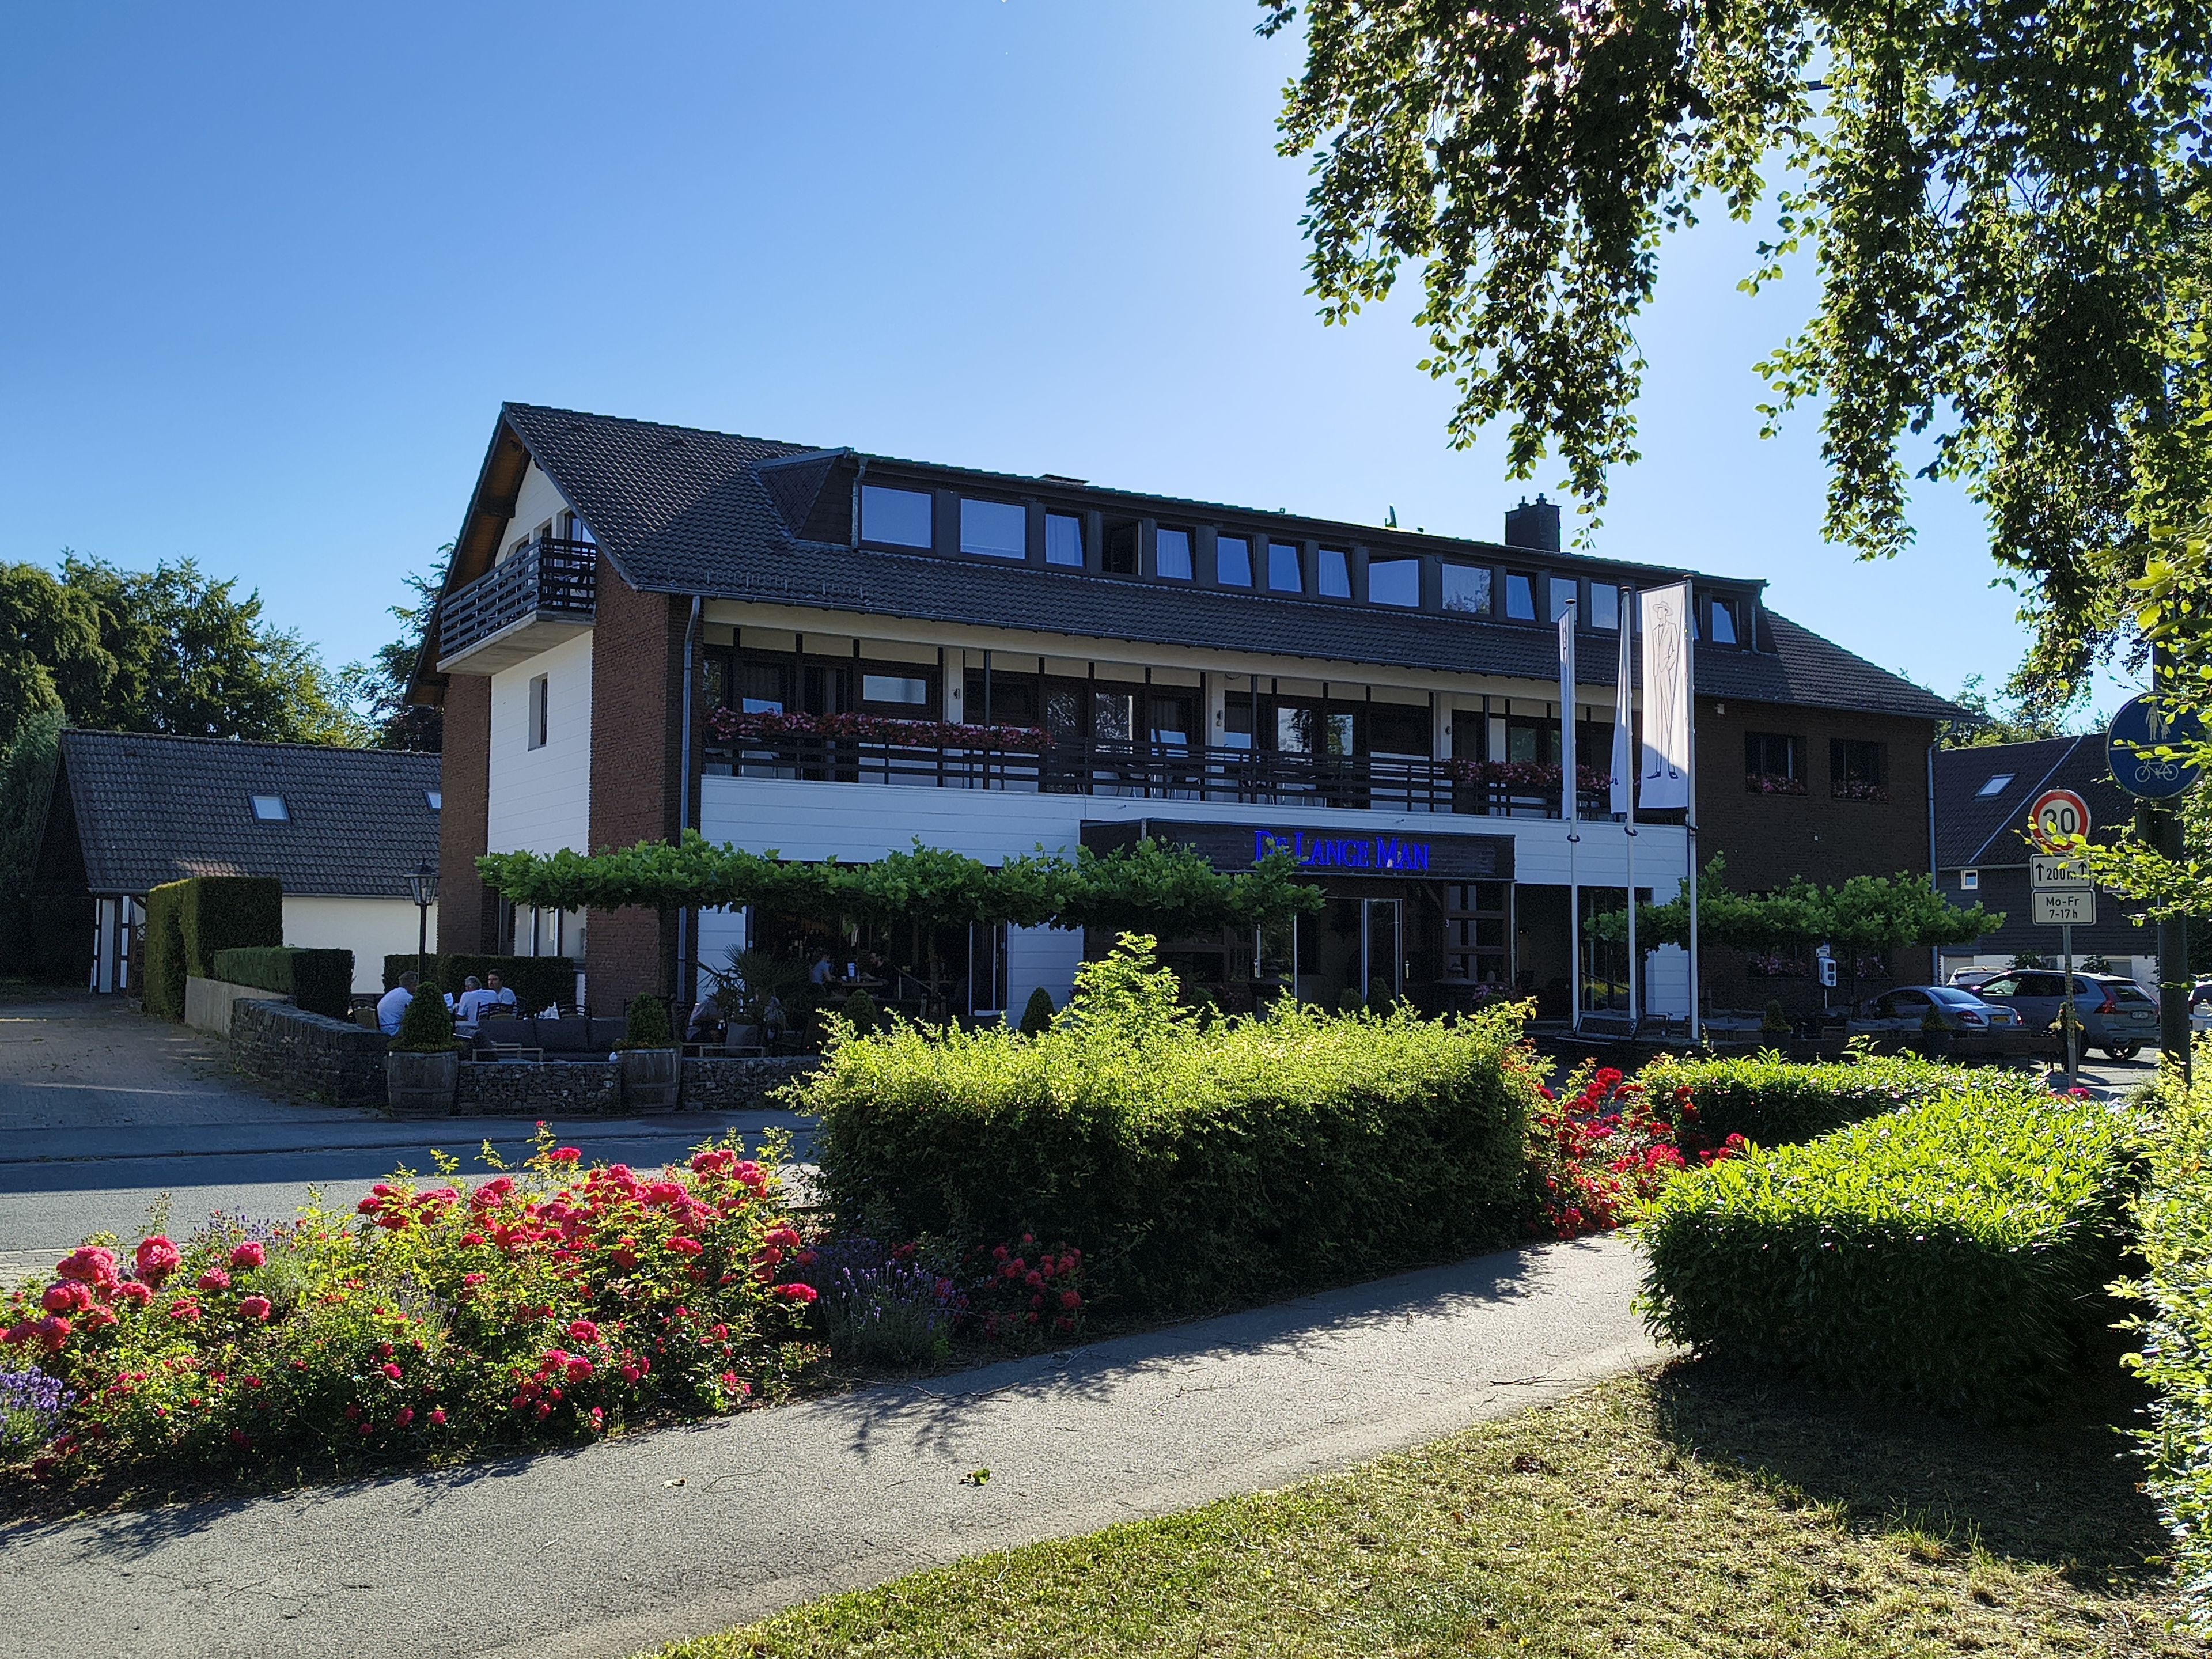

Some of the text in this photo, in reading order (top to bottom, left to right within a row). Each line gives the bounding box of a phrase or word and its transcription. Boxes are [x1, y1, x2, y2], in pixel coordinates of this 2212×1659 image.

[2043, 808, 2075, 835] 30
[1294, 832, 1369, 868] LANGE
[1375, 836, 1430, 870] MAN
[2046, 896, 2080, 906] Mo-Fr
[2049, 908, 2077, 919] 7-17 h
